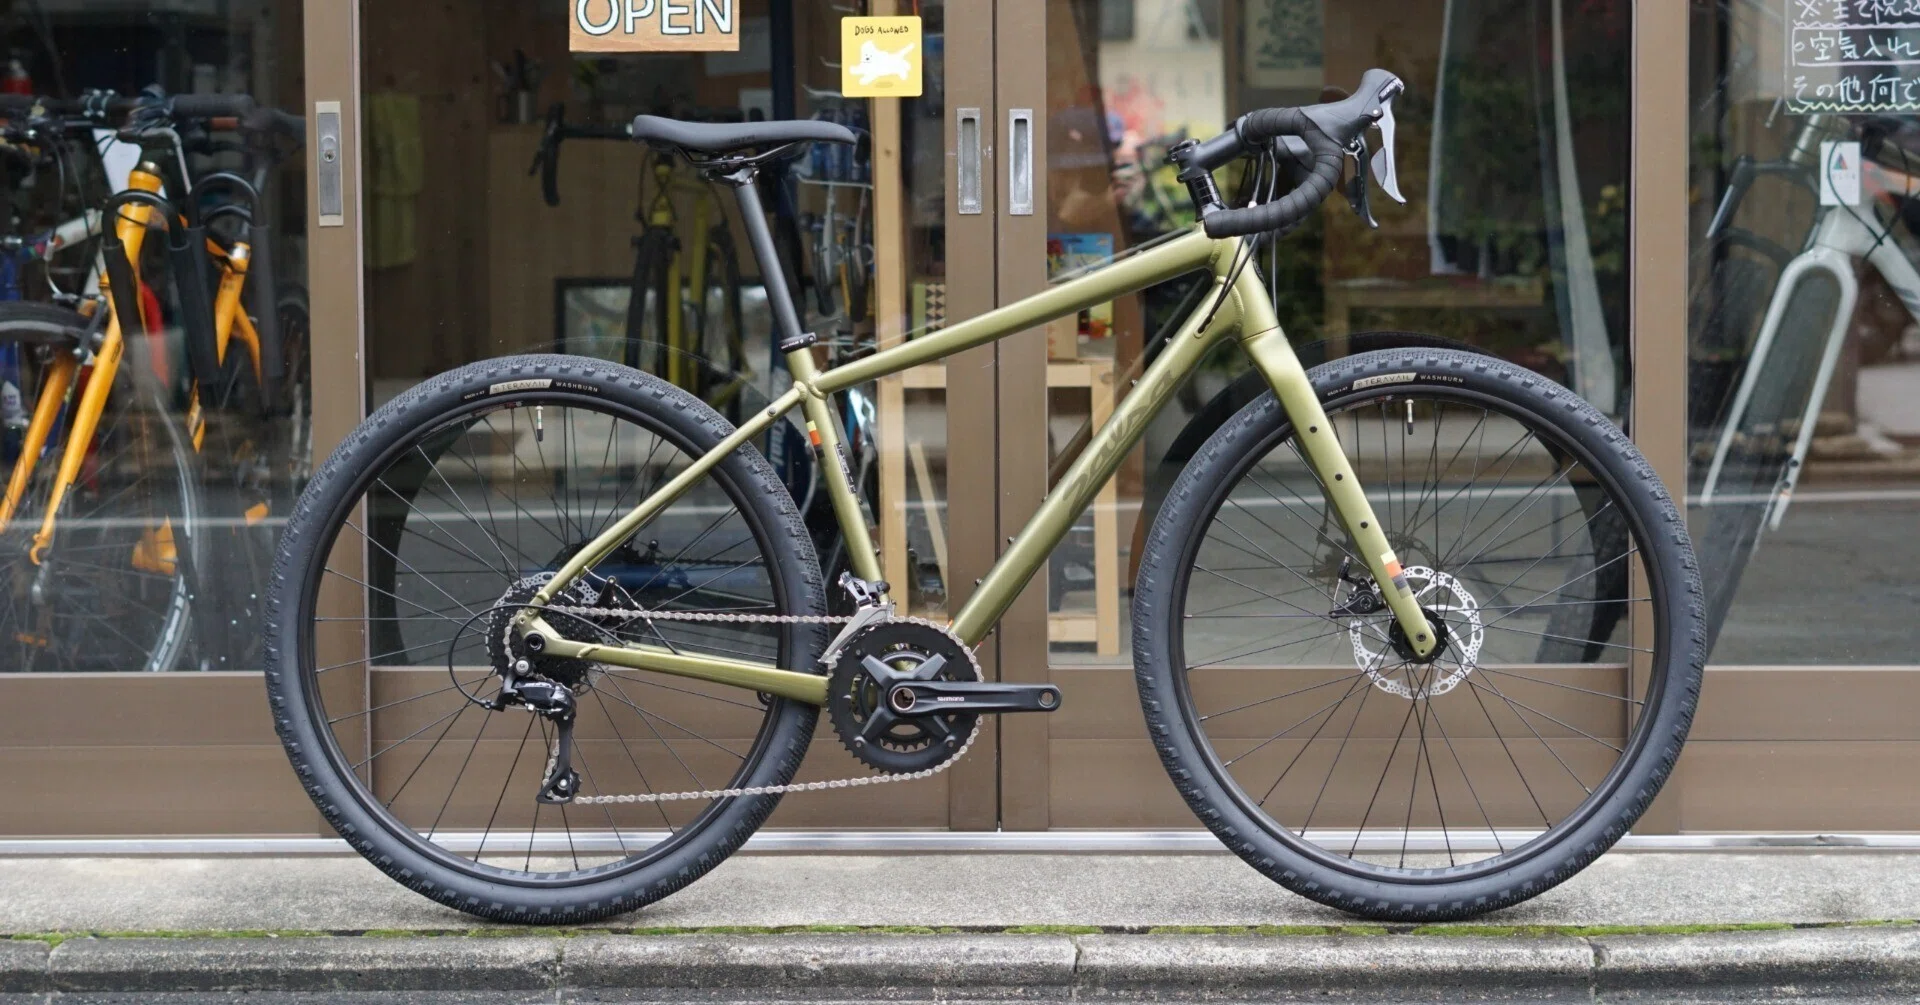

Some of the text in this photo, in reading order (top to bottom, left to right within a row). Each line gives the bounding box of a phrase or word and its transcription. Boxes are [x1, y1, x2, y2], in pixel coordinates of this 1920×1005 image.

[576, 0, 732, 36] OPEN
[855, 25, 874, 36] DOGS
[1364, 375, 1464, 386] TERAVAIL WASHBURN
[501, 381, 598, 393] TERAVAIL WASHBURN
